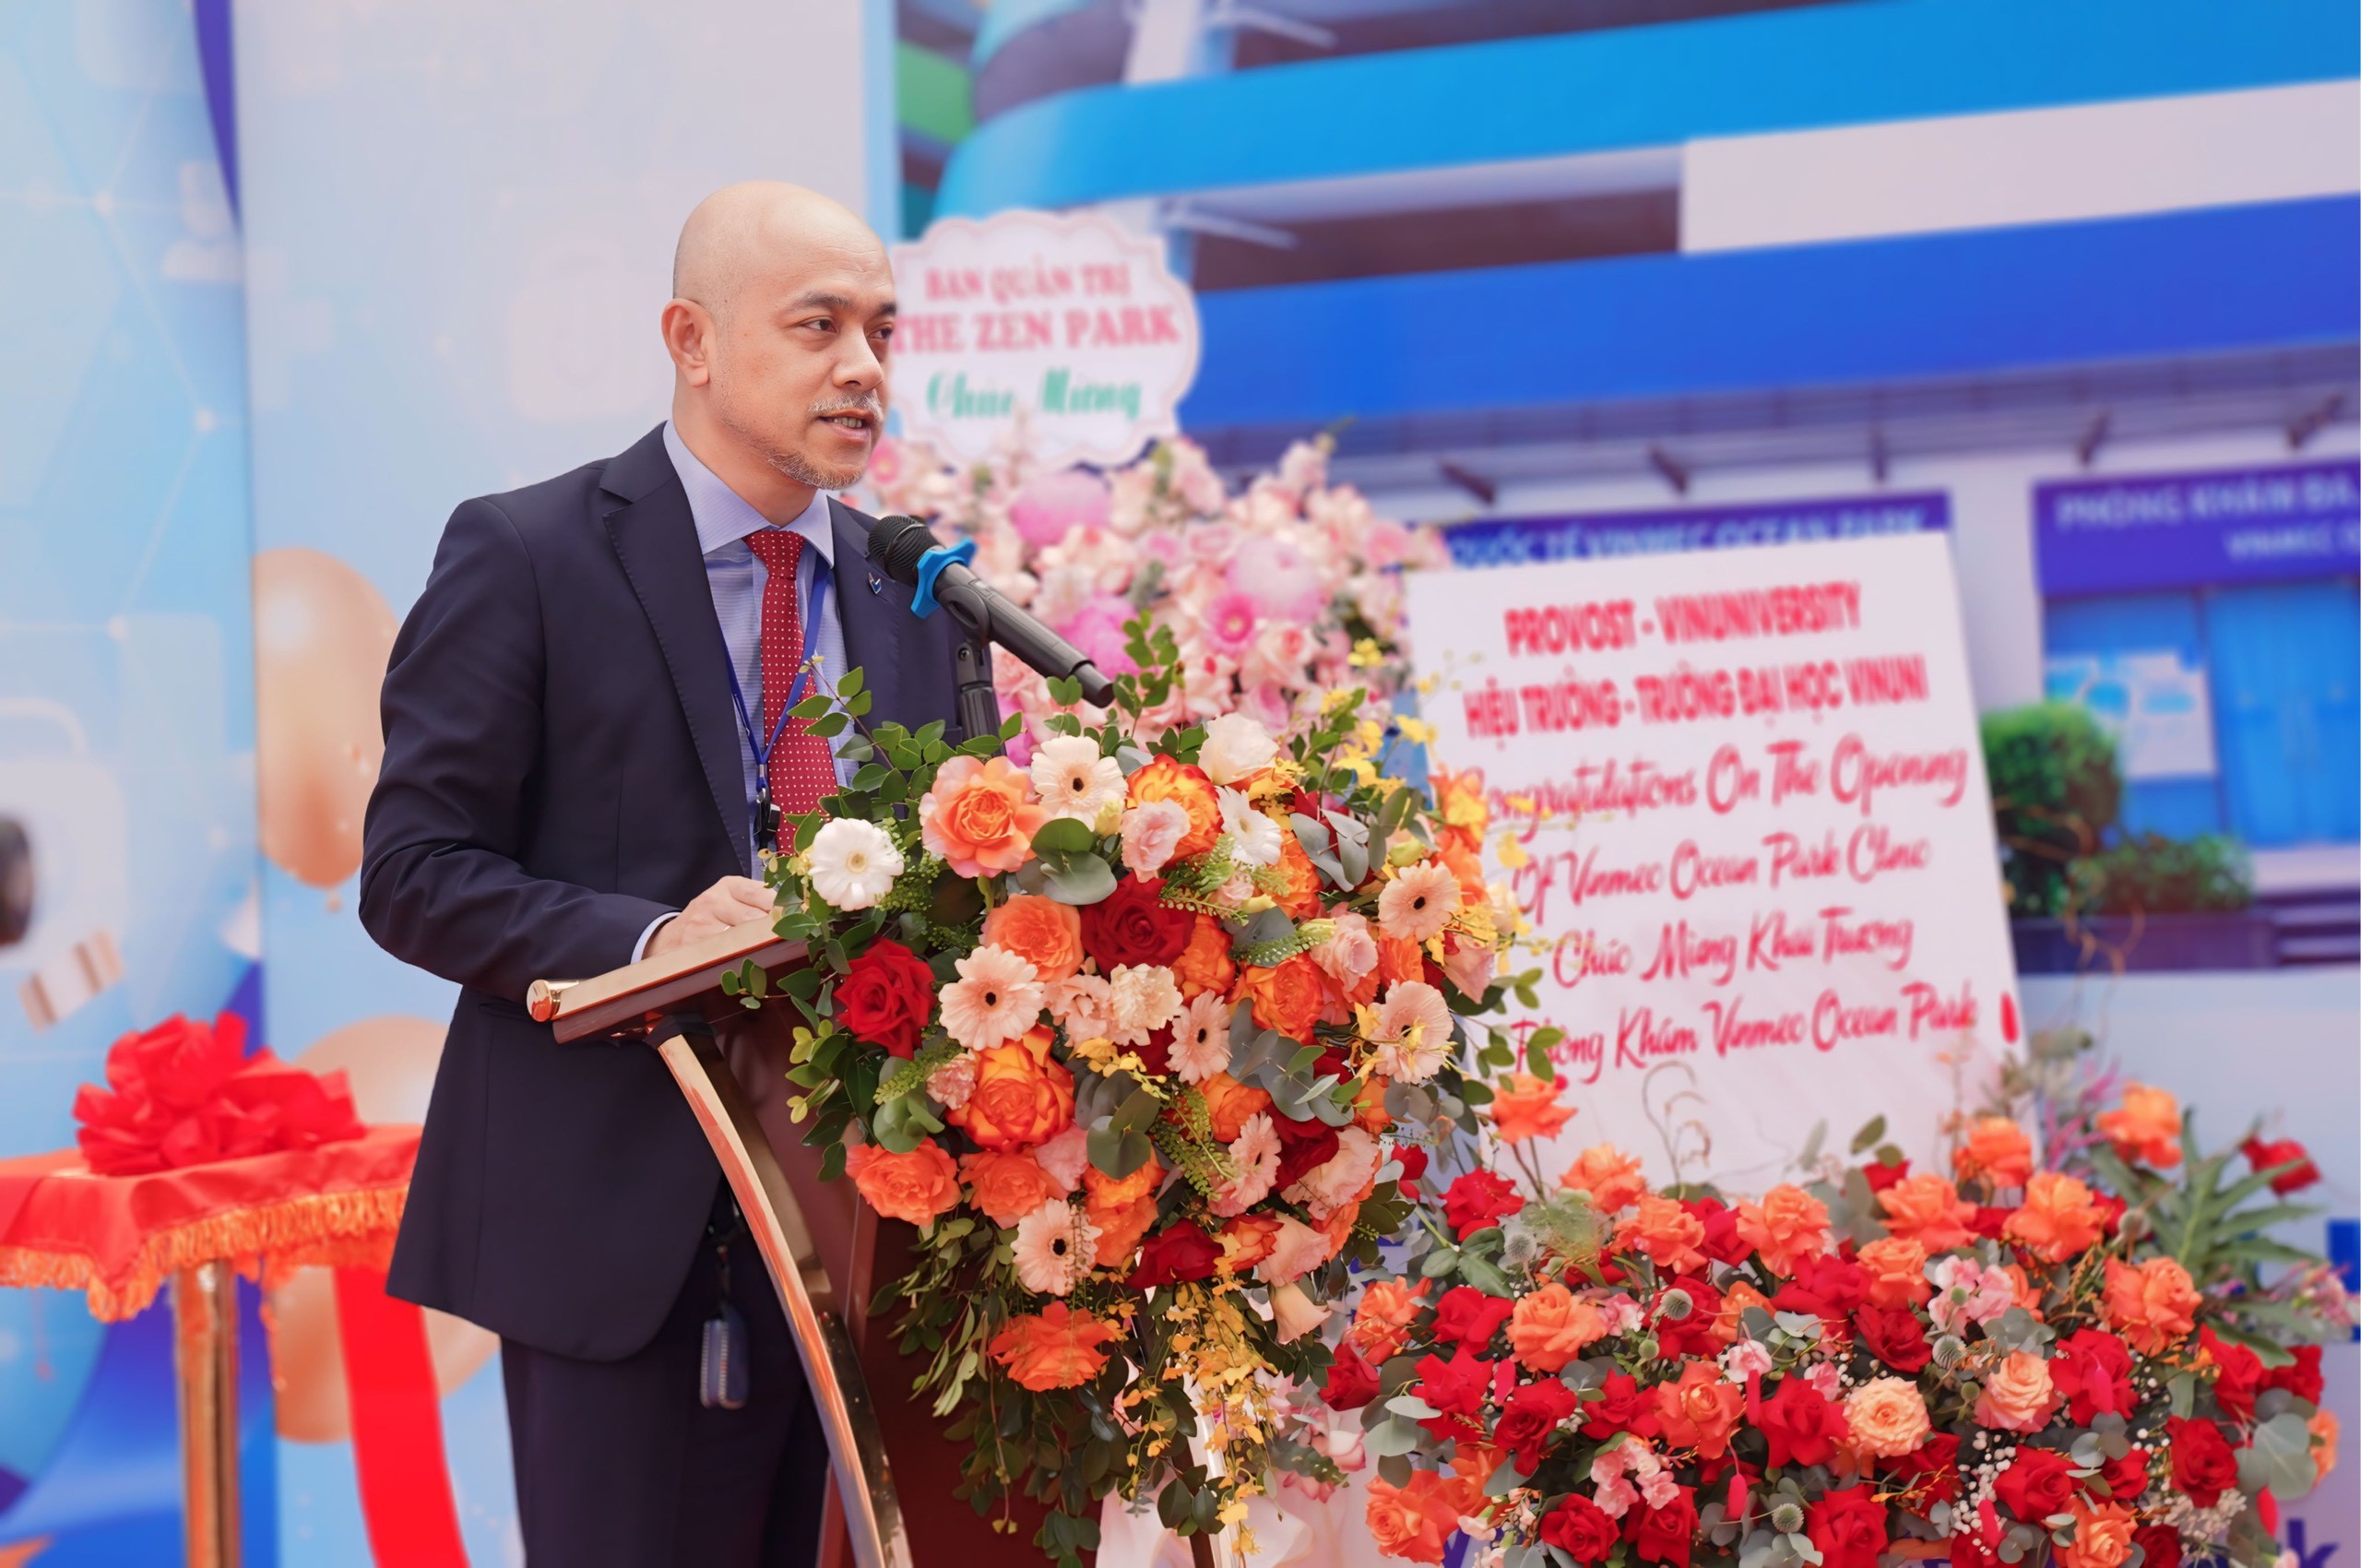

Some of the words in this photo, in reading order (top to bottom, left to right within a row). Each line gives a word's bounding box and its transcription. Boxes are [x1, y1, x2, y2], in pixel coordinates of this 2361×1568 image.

[924, 267, 984, 301] BAN
[893, 313, 967, 354] THE
[974, 308, 1054, 352] ZEN
[1063, 304, 1181, 349] PARK
[1504, 598, 1636, 659] PROVOST
[1654, 580, 1861, 645] VINUNIVERSITY
[1842, 652, 1930, 707] VINUNI
[1706, 742, 1761, 815] On
[1765, 740, 1821, 808] The
[1830, 732, 1968, 818] Opening
[1557, 843, 1665, 907] Vinmec
[1669, 837, 1760, 901] Ocean
[1762, 827, 1842, 891] Park
[1845, 823, 1932, 885] Clinic
[1746, 909, 1815, 972] Khai
[1700, 992, 1808, 1060] Vinmec
[1810, 987, 1899, 1052] Ocean
[1899, 975, 1978, 1043] Park
